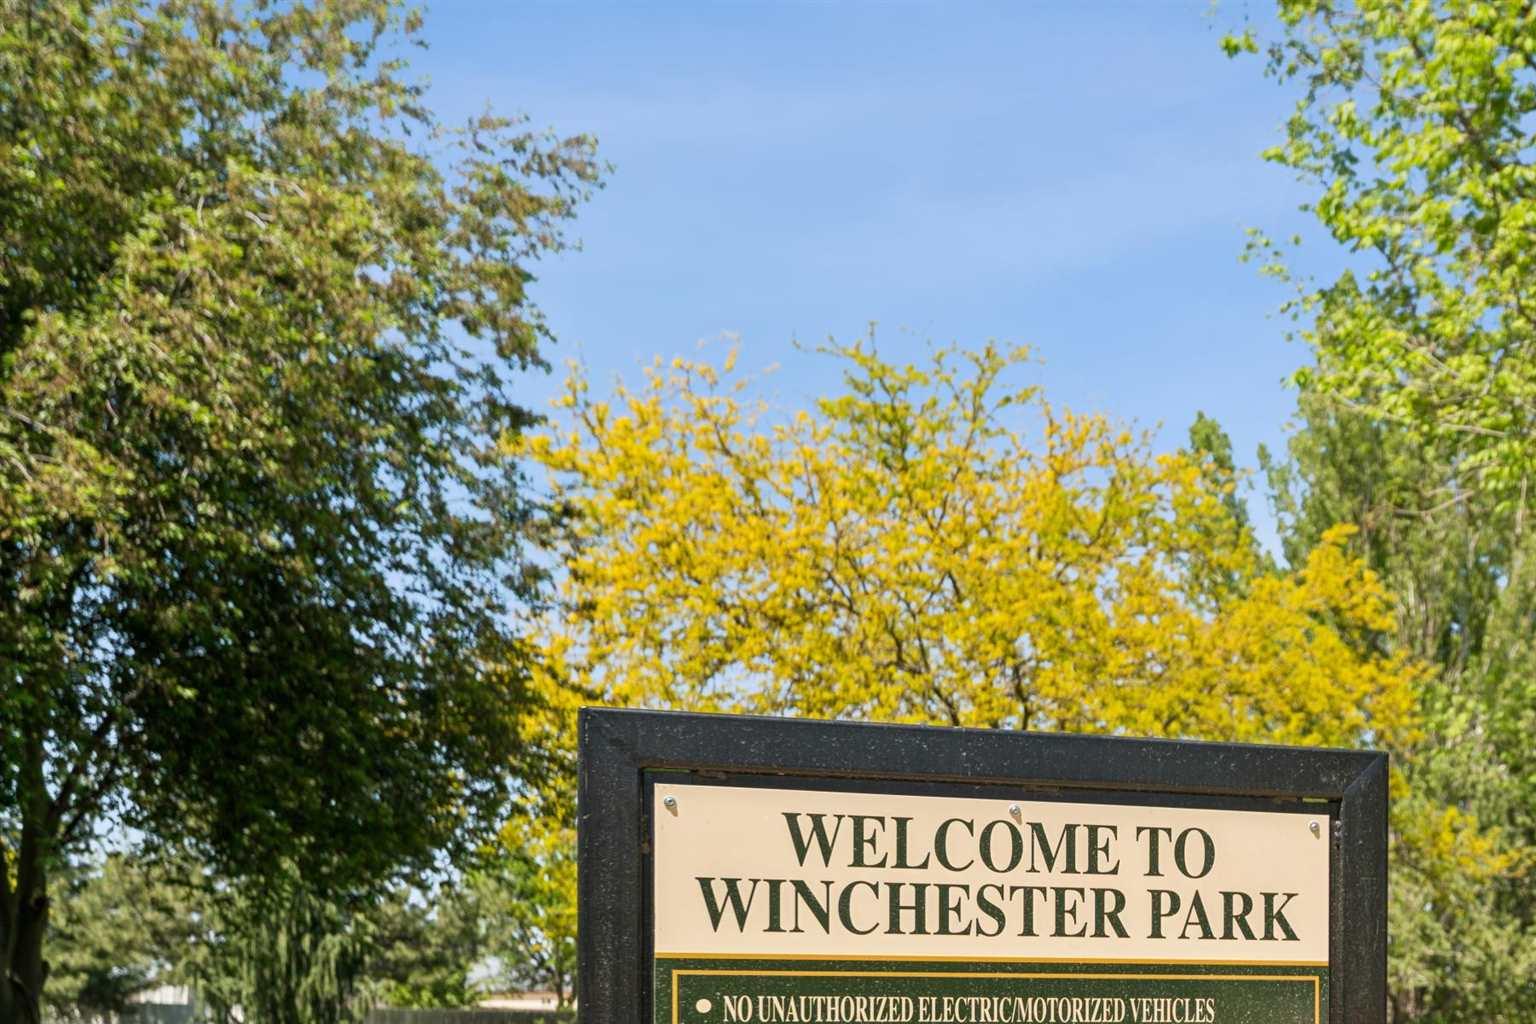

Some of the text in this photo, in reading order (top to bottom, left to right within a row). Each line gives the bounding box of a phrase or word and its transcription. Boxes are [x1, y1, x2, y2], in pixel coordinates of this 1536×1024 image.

[783, 812, 1215, 878] WELCOME TO
[695, 876, 1299, 942] WINCHESTER PARK
[723, 995, 1215, 1024] NO UNAUTHORIZED ELECTRIC/MOTORIZED VEHICLES
